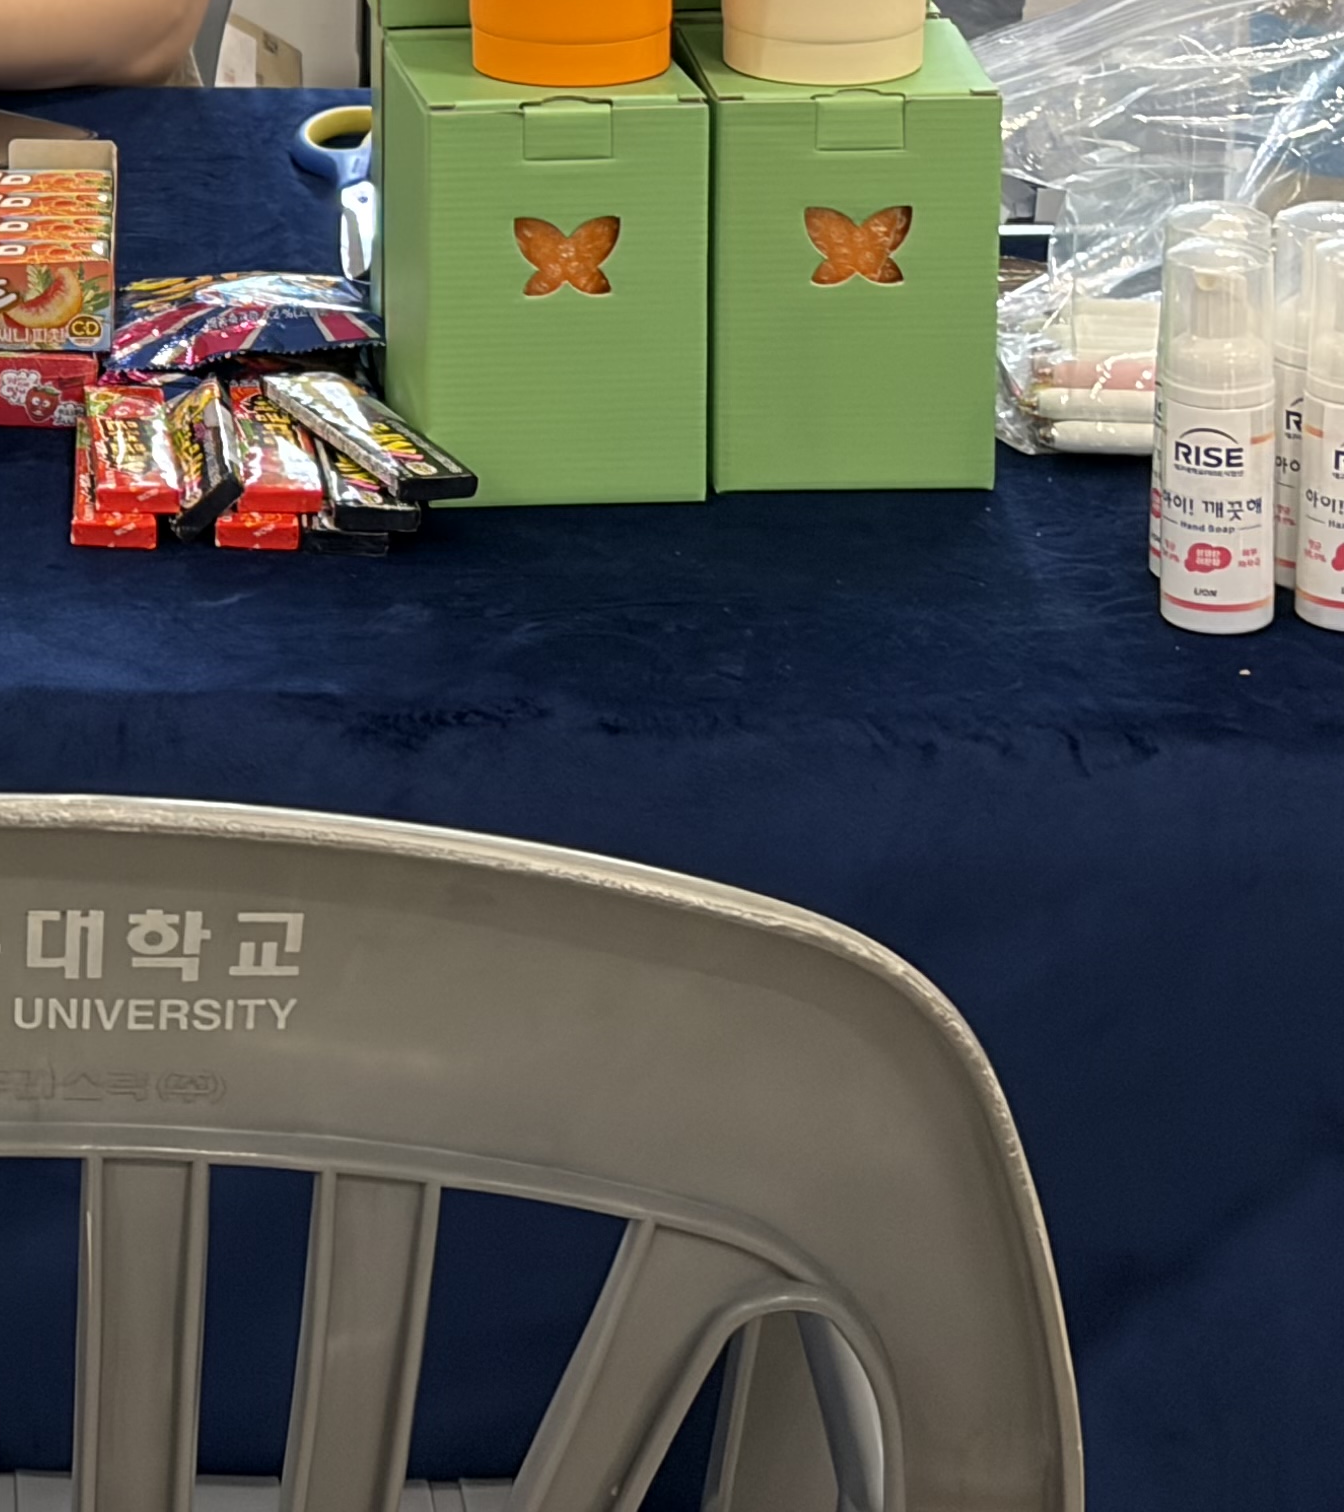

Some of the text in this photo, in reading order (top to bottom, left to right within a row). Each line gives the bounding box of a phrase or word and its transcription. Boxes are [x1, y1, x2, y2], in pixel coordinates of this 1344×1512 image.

[1173, 439, 1245, 469] RISE
[1202, 496, 1263, 521] 깨끗해
[14, 996, 299, 1031] UNIVERSITY
